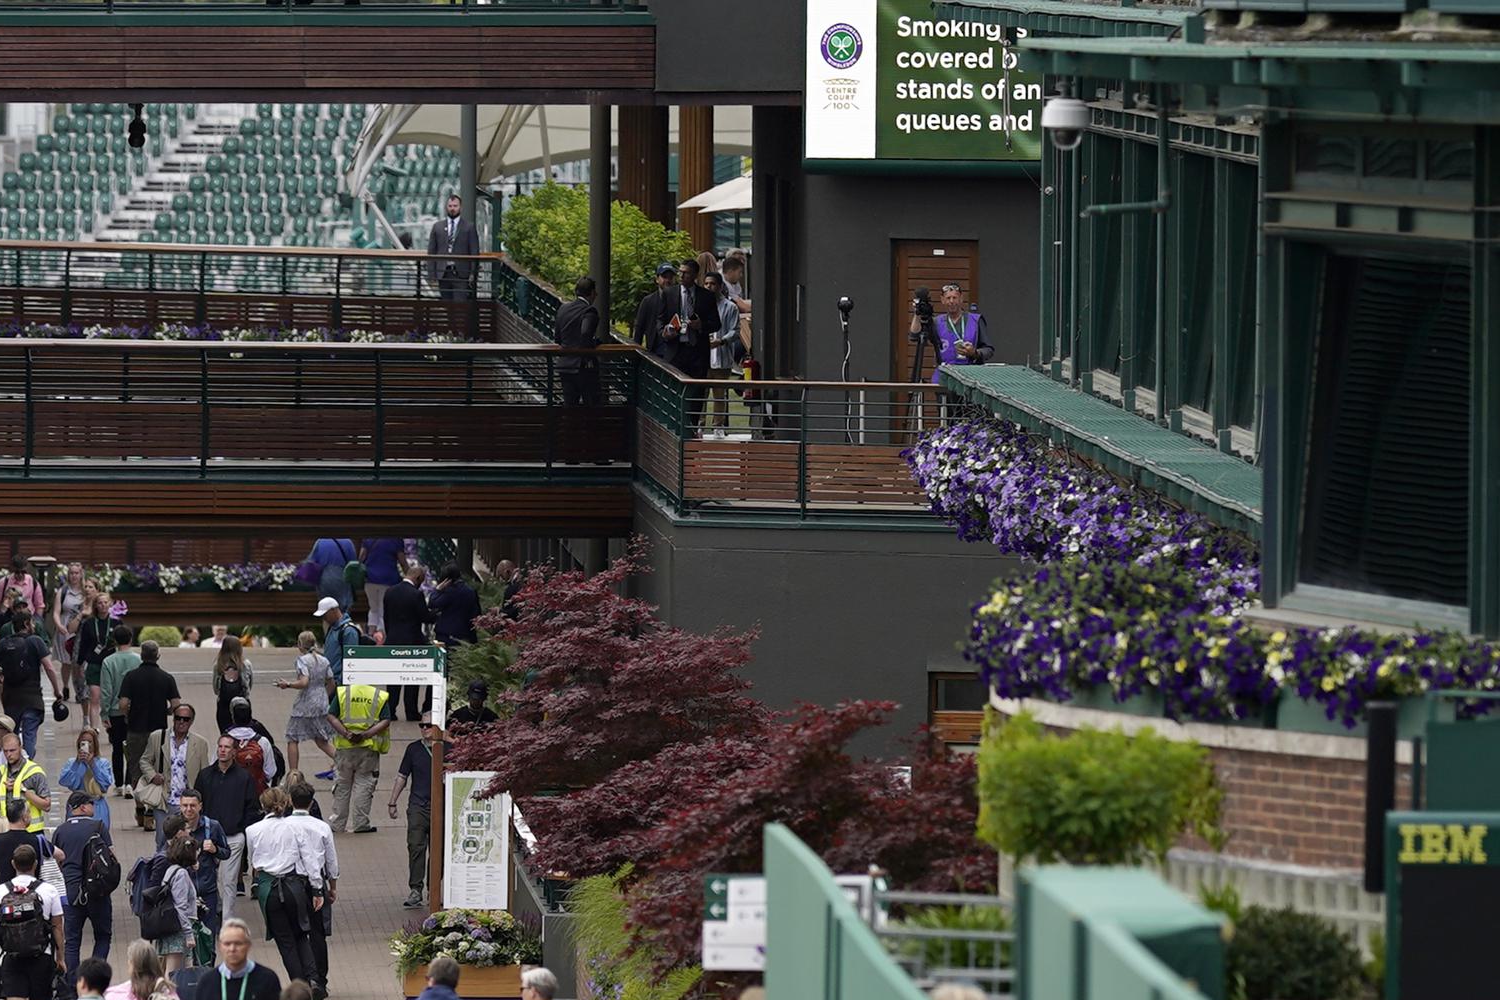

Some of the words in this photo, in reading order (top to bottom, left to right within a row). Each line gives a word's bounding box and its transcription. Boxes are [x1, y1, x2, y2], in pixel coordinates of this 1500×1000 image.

[897, 16, 1001, 41] Smoking
[896, 47, 994, 69] covered
[896, 78, 974, 100] stands
[981, 78, 1006, 100] of
[833, 102, 851, 110] 100
[896, 113, 982, 133] queues
[988, 110, 1033, 131] and
[1399, 823, 1488, 864] IBM
